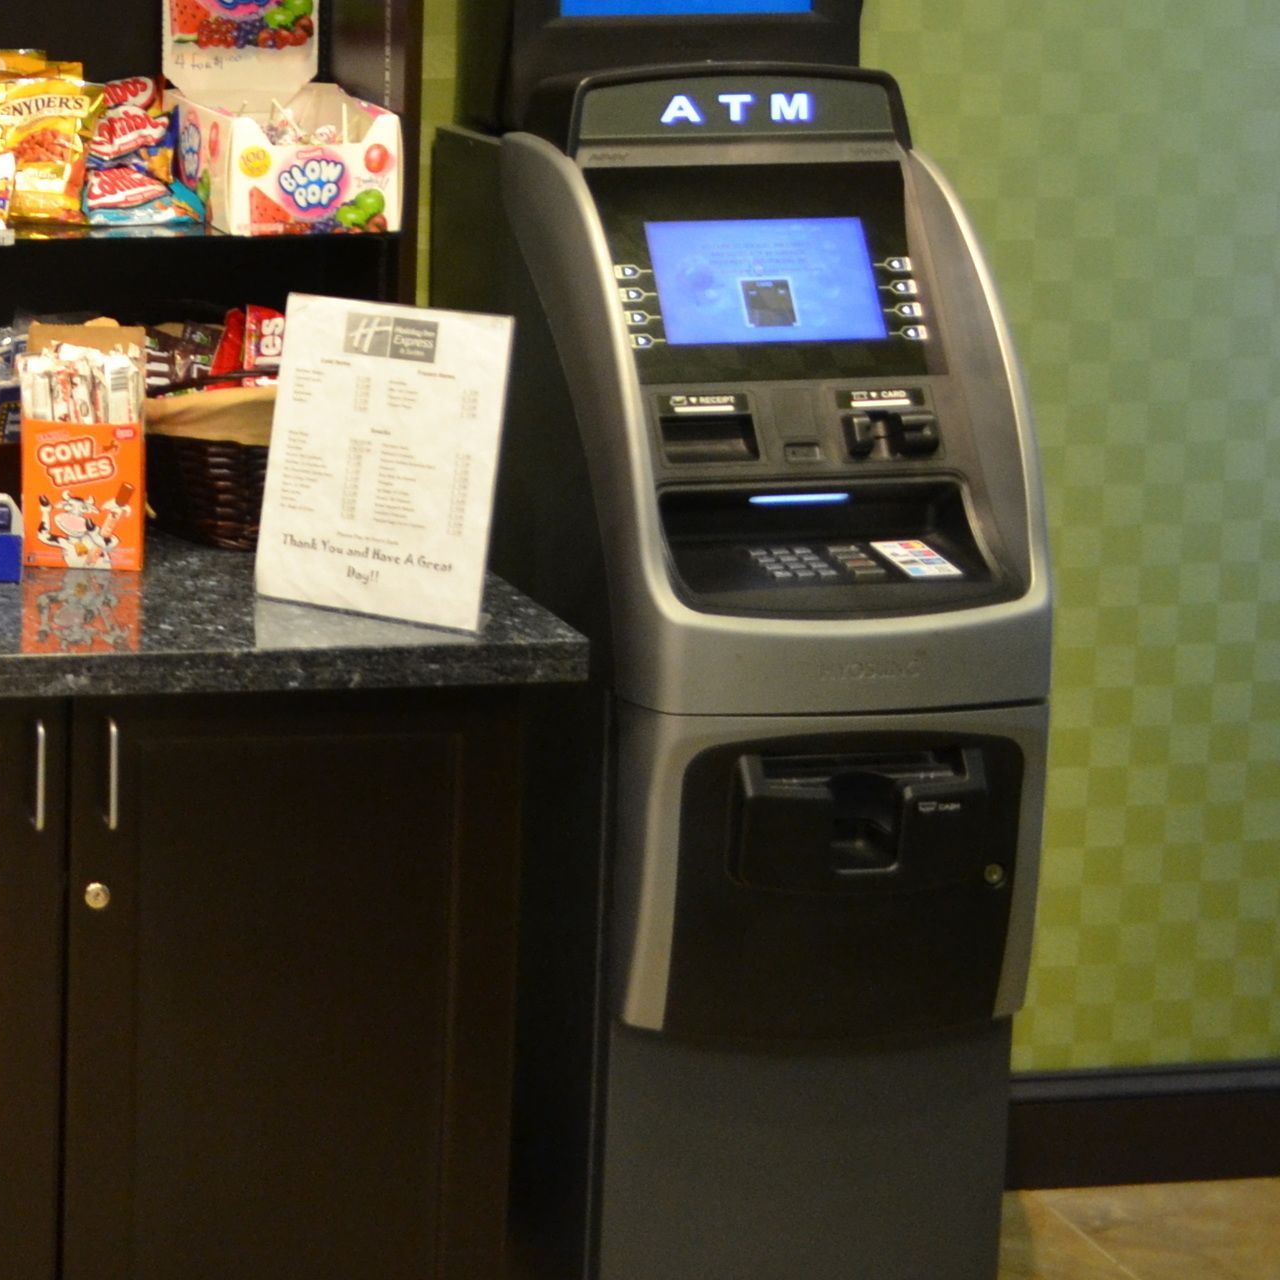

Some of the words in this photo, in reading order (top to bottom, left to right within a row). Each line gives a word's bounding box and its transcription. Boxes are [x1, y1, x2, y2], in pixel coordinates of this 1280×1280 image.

[0, 96, 85, 117] SNYDER'S
[659, 92, 813, 123] ATM
[240, 149, 267, 165] 100
[279, 160, 343, 193] BLOW
[293, 183, 339, 208] POP
[393, 334, 434, 350] Express
[697, 394, 736, 406] RECEIPT
[880, 388, 908, 400] CARD
[40, 439, 93, 465] COW
[48, 458, 113, 486] TALES
[282, 532, 318, 553] Thank
[319, 538, 344, 556] You
[347, 545, 369, 560] and
[371, 548, 401, 565] Have
[404, 552, 415, 565] A
[417, 554, 453, 573] Great
